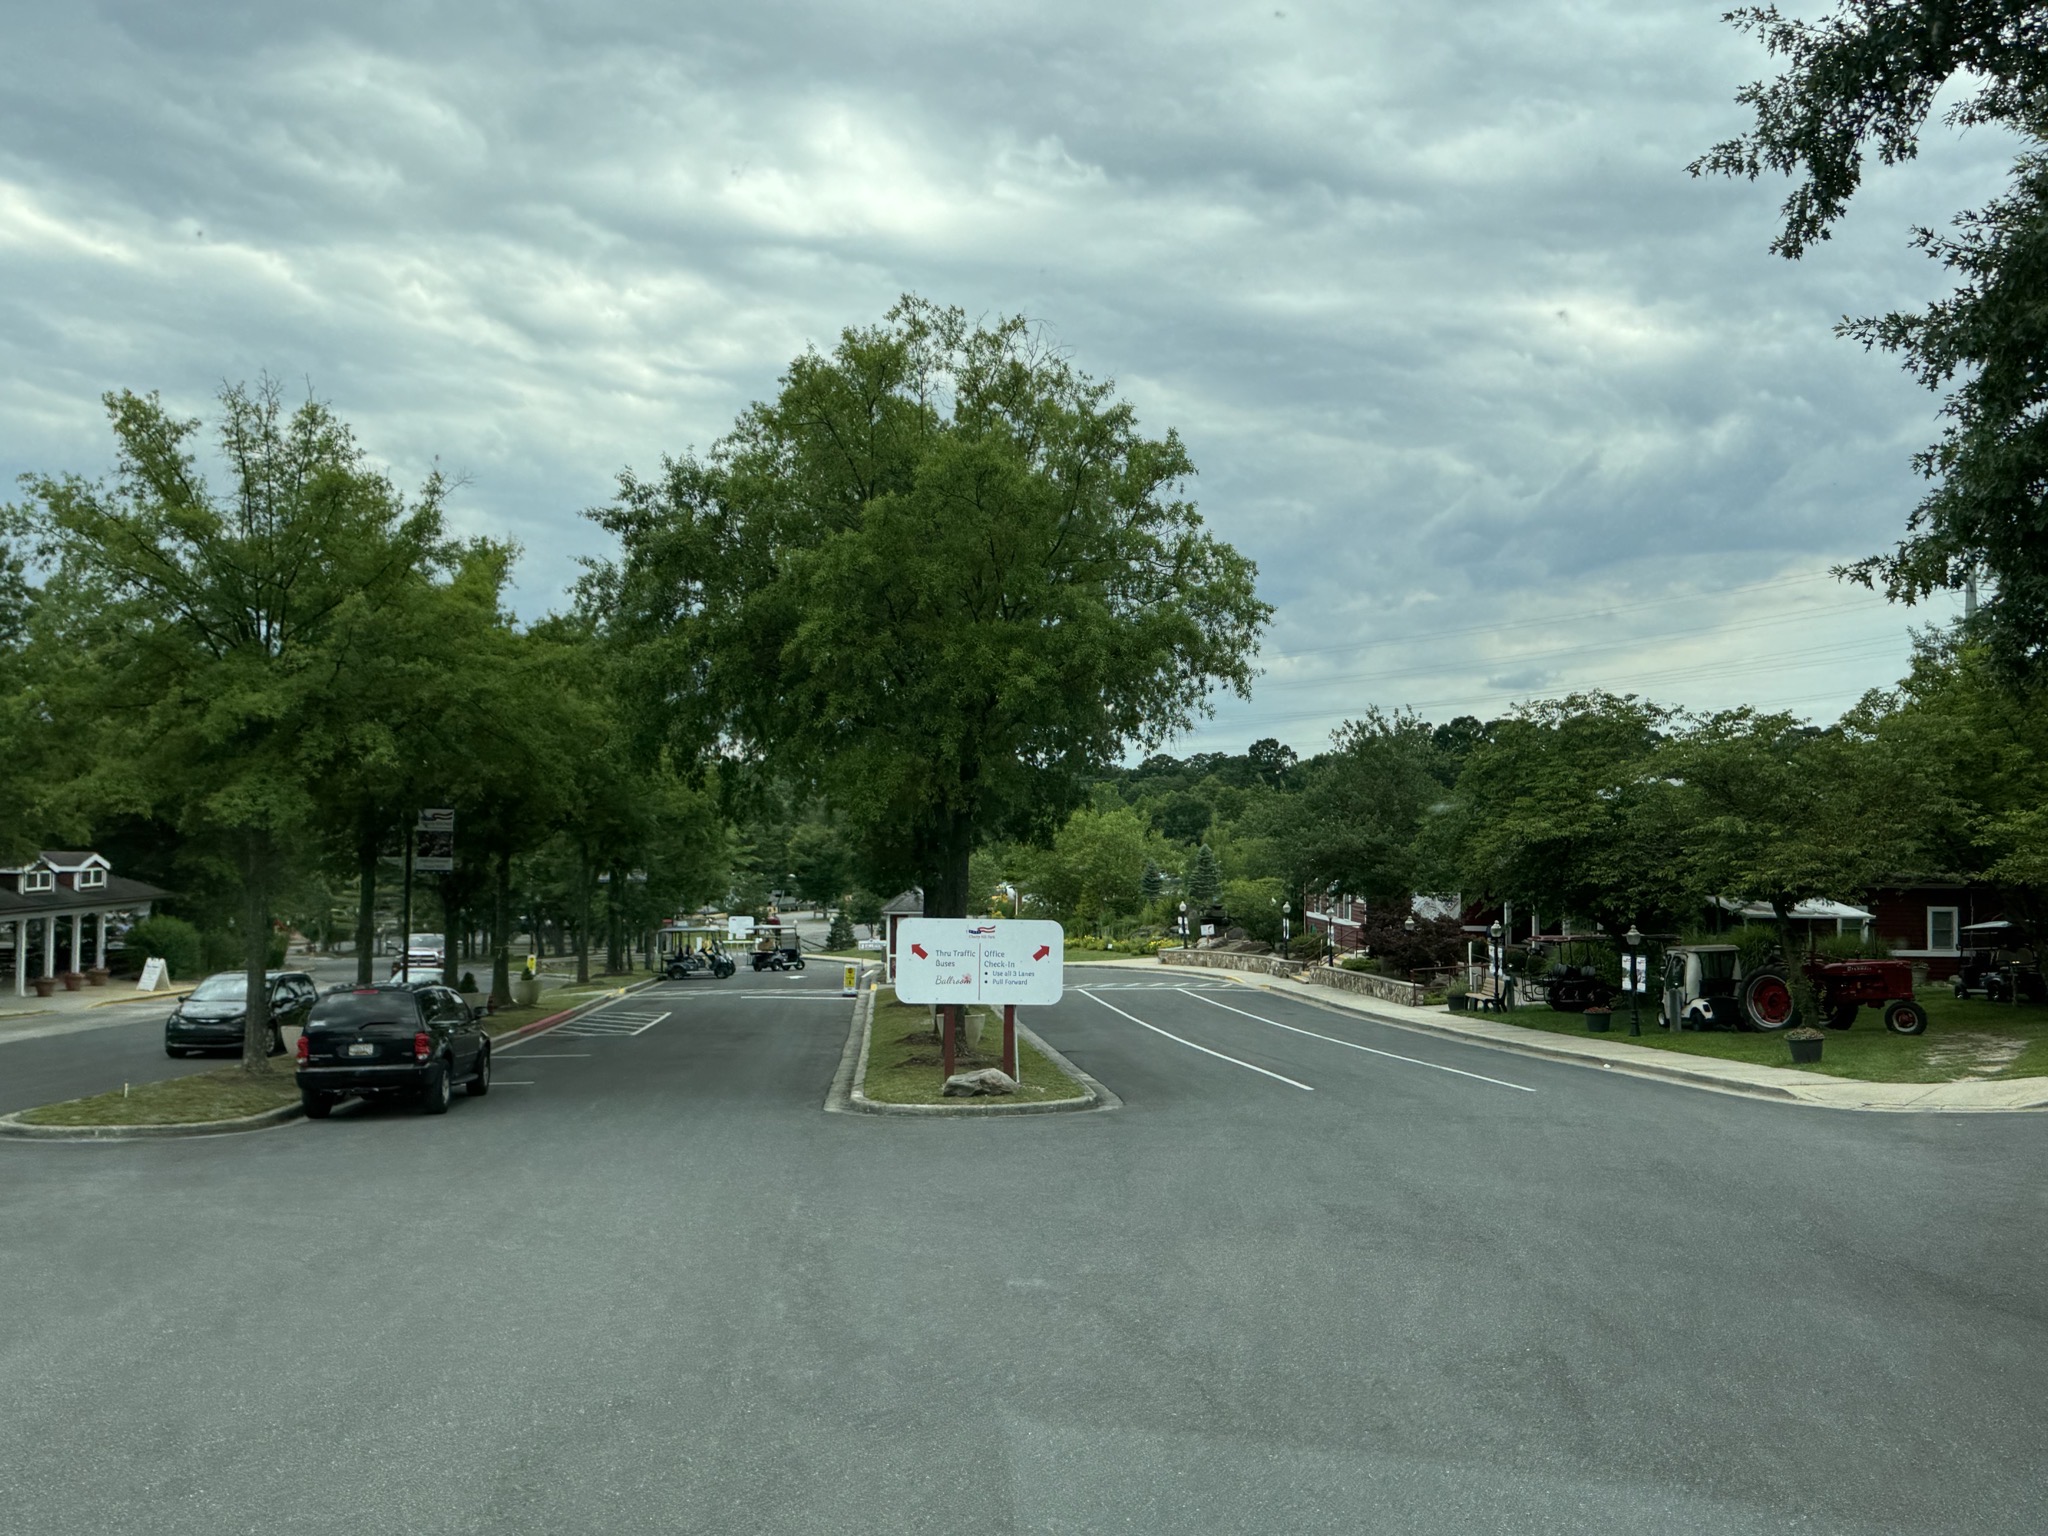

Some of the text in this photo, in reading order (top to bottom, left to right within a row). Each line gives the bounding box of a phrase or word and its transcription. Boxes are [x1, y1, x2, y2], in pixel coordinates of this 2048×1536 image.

[935, 949, 976, 957] Thru Traffic
[984, 950, 1005, 958] Office
[935, 959, 956, 967] Buses
[984, 960, 1015, 968] Check-In
[935, 974, 972, 985] Ballroom
